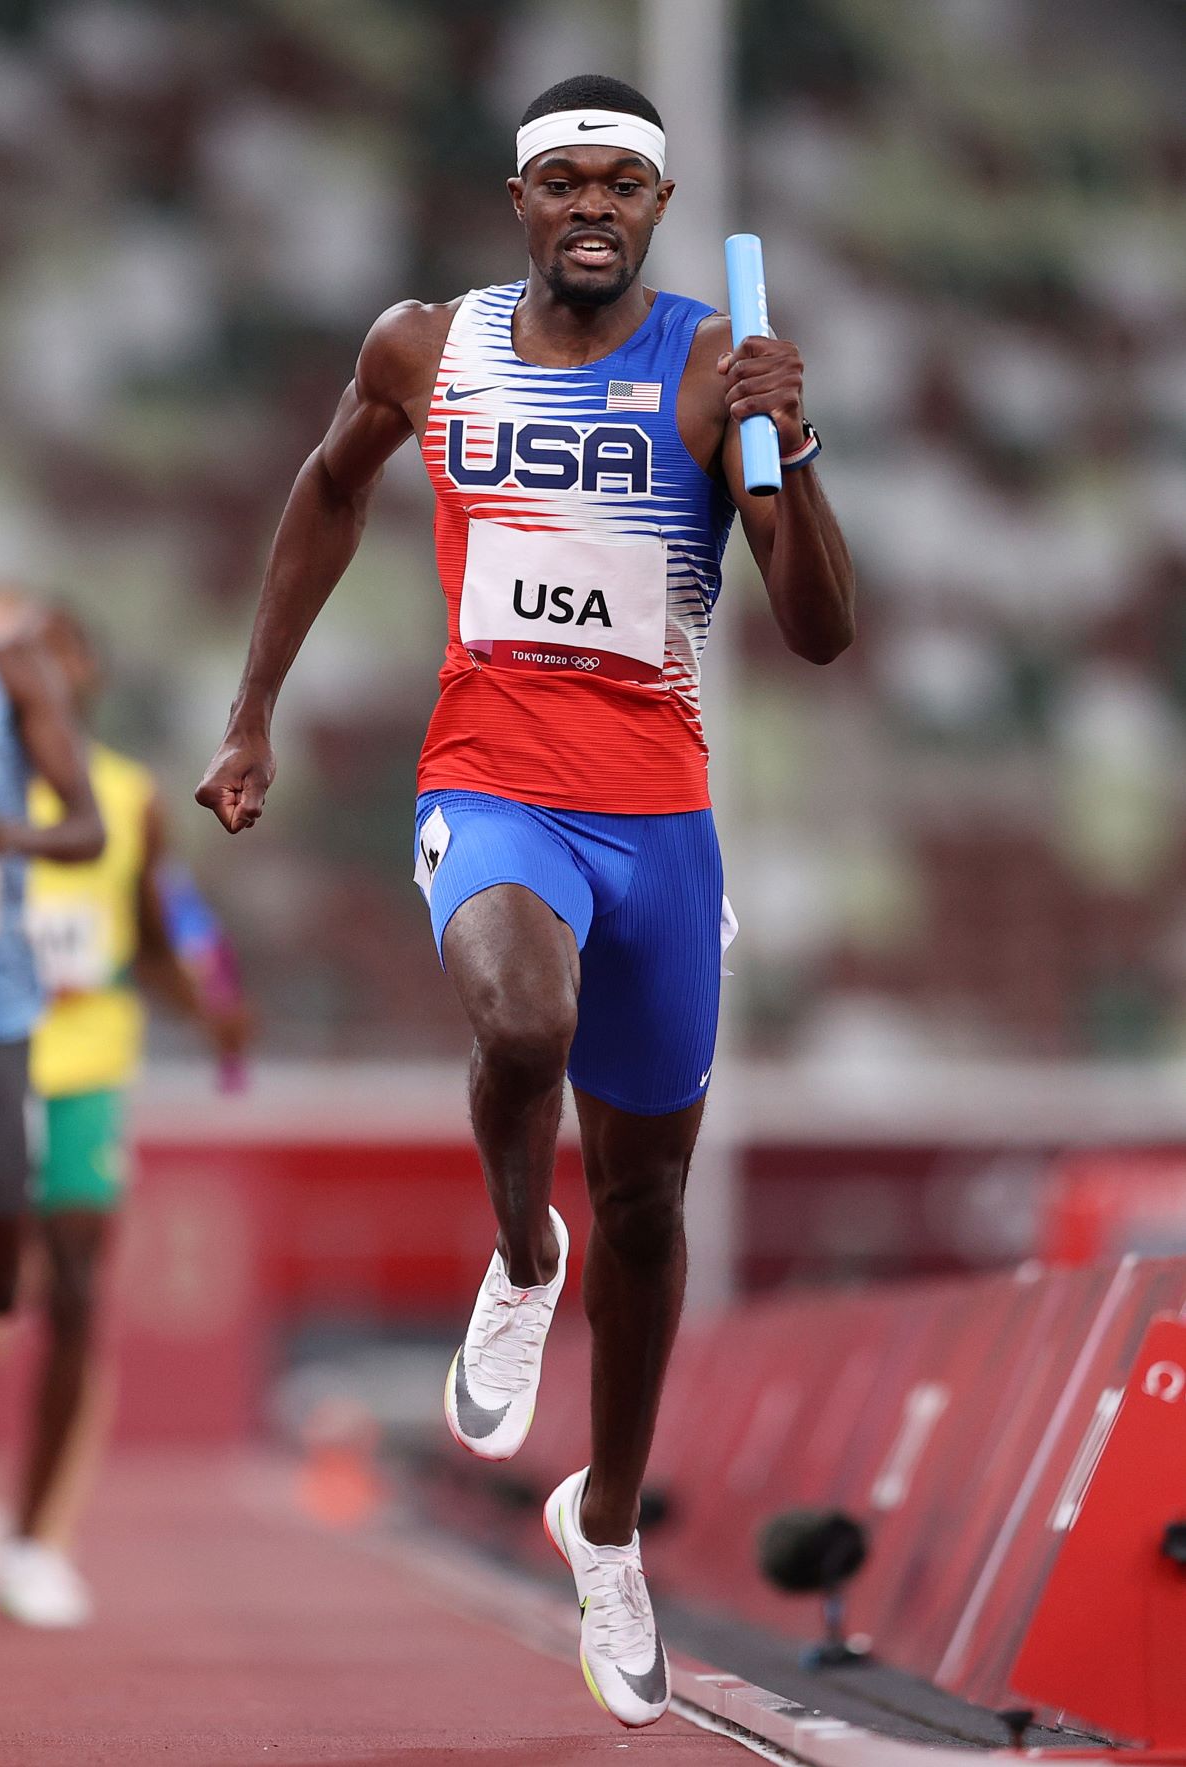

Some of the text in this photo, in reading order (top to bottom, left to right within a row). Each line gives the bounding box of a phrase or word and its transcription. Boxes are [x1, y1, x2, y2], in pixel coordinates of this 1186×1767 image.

[447, 418, 651, 494] USA
[513, 579, 612, 627] USA
[512, 651, 567, 665] TOKYO 2020
